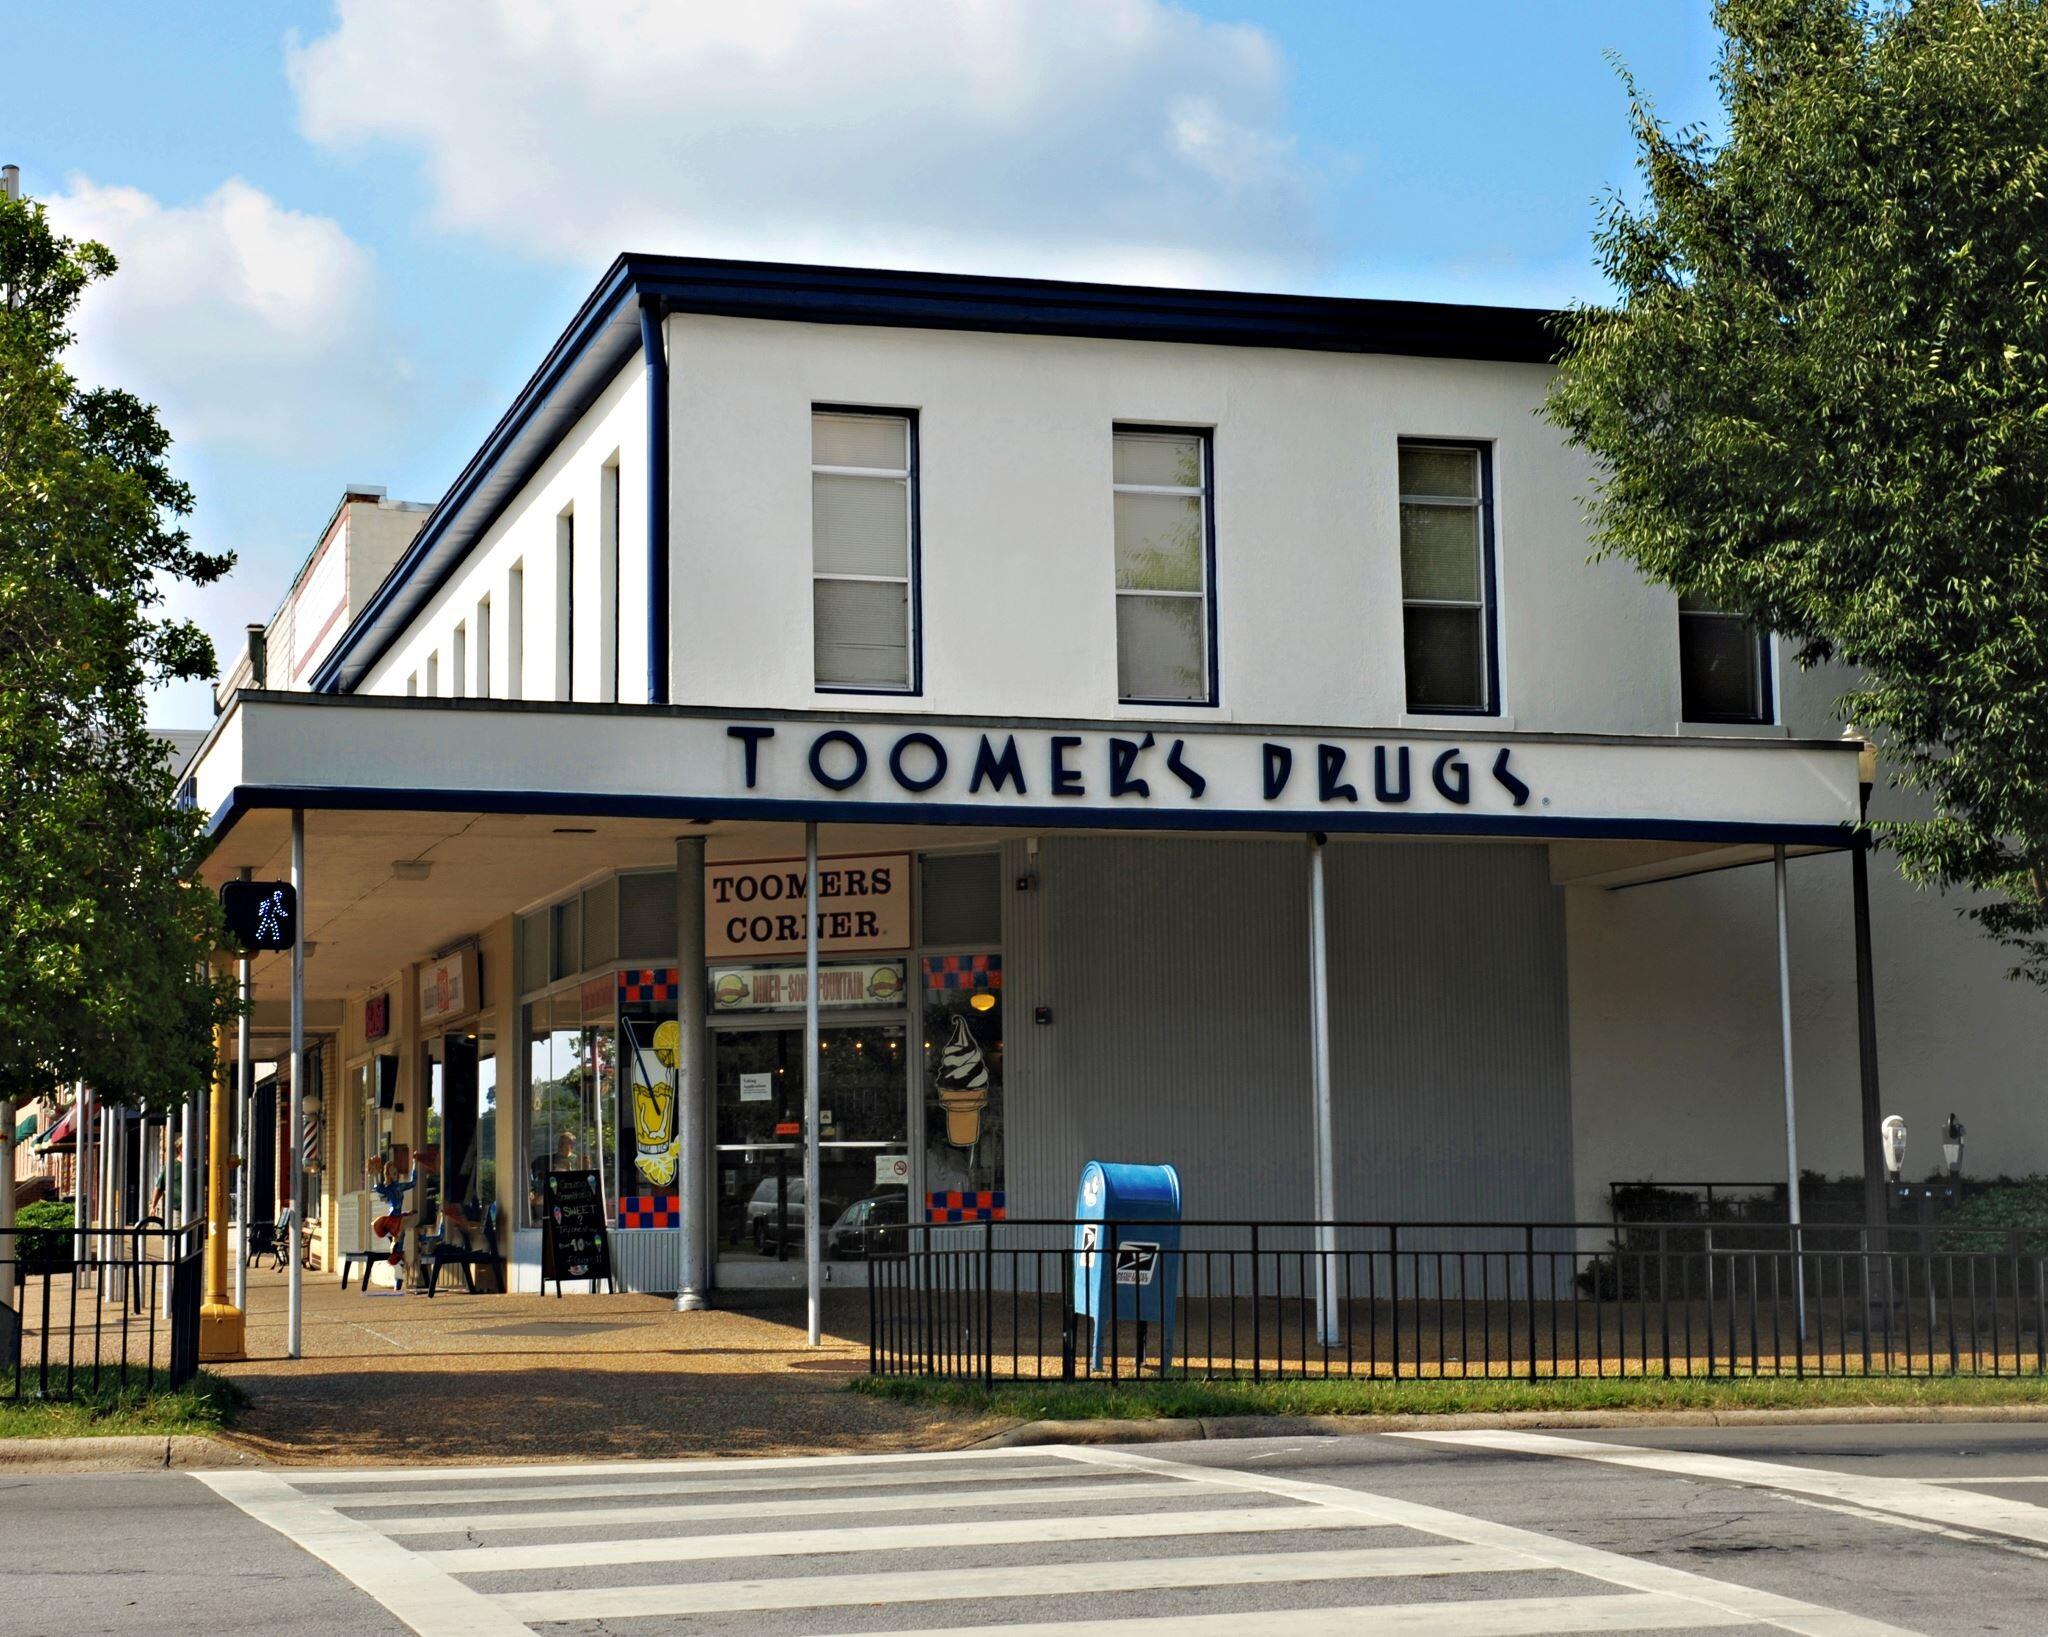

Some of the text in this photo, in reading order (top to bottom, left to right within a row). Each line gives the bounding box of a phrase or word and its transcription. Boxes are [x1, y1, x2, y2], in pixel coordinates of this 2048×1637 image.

[727, 726, 1531, 807] TOOMER'S DRUGS
[753, 974, 808, 1004] DINER-SOD
[562, 1204, 597, 1218] SWEET
